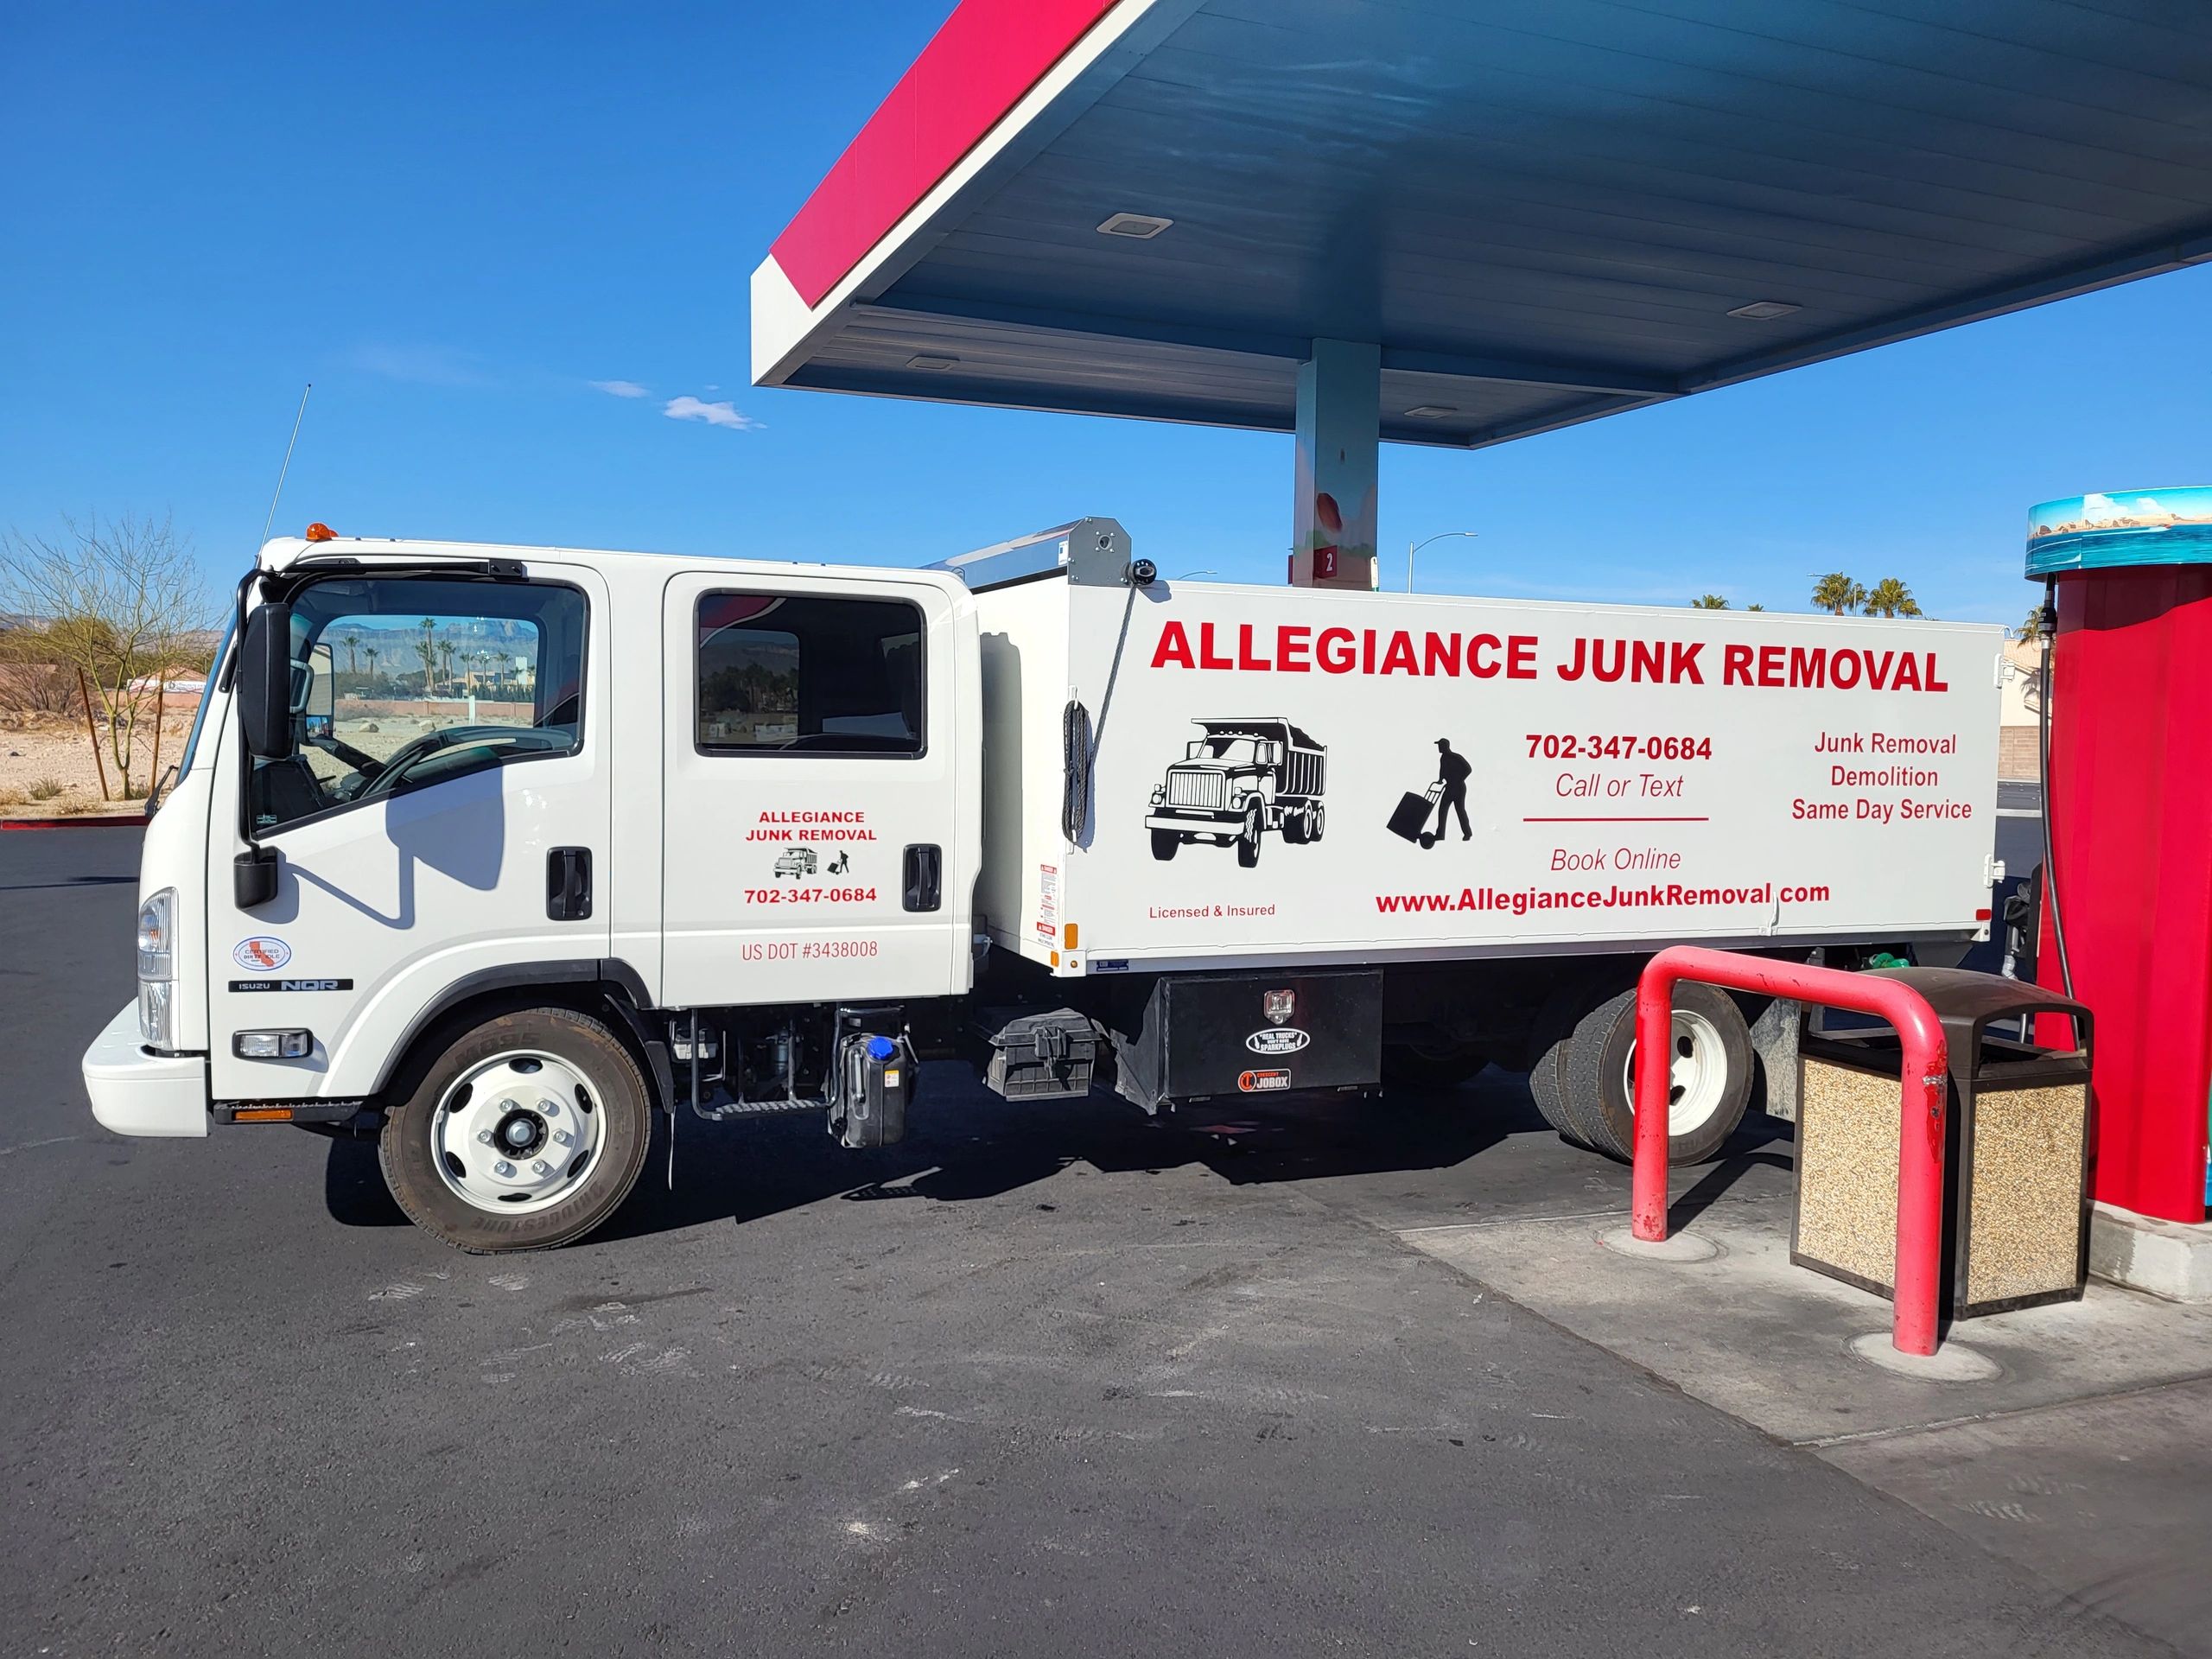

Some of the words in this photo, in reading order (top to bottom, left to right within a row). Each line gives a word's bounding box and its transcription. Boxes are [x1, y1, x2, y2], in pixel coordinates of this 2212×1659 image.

[1325, 552, 1333, 572] 2
[1149, 620, 1539, 680] ALLEGIANCE
[1555, 637, 1706, 685] JUNK
[1722, 643, 1949, 693] REMOVAL
[1525, 734, 1713, 761] 702-347-0684
[1814, 732, 1863, 753] Junk
[1871, 732, 1957, 754] Removal
[1556, 772, 1600, 797] Call
[1607, 779, 1631, 797] or
[1640, 773, 1684, 798] Text
[1831, 765, 1939, 787] Demolition
[759, 811, 865, 823] ALLEGIANCE
[1791, 798, 1849, 820] Same
[1855, 798, 1894, 825] Day
[1900, 798, 1973, 820] Service
[746, 830, 793, 842] JUNK
[798, 829, 877, 842] REMOVAL
[1551, 849, 1607, 871] Book
[1614, 847, 1681, 870] Online
[744, 887, 877, 904] 702-347-0684
[1375, 881, 1830, 917] www.AllegianceJunkRemovalcom
[1149, 906, 1210, 918] Licensed
[1213, 906, 1223, 917] &
[1227, 904, 1275, 917] Insured
[741, 944, 763, 961] US
[767, 943, 798, 959] DOT
[803, 941, 878, 958] #3438008
[281, 980, 339, 991] NQR
[1256, 1076, 1288, 1089] JOBOX
